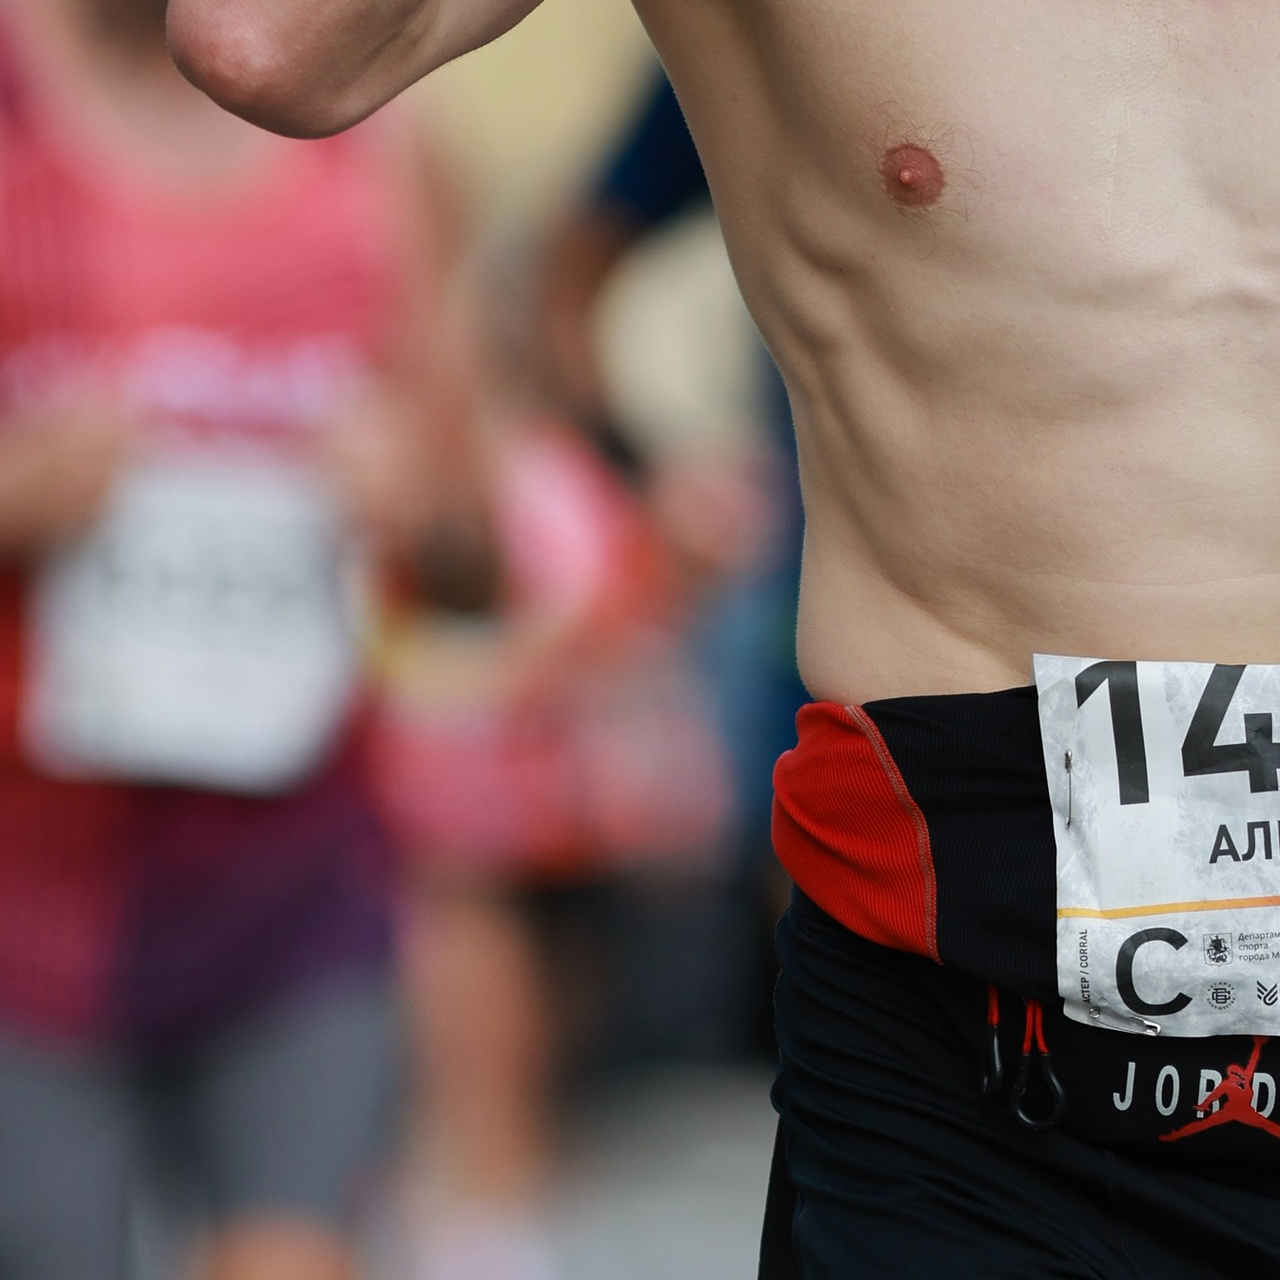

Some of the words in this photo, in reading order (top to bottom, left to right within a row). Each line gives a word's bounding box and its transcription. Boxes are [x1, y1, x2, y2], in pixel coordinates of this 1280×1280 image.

[1079, 928, 1088, 968] CORRAL
[1238, 942, 1269, 951] спорта
[1239, 954, 1270, 962] города
[1116, 927, 1193, 1016] C
